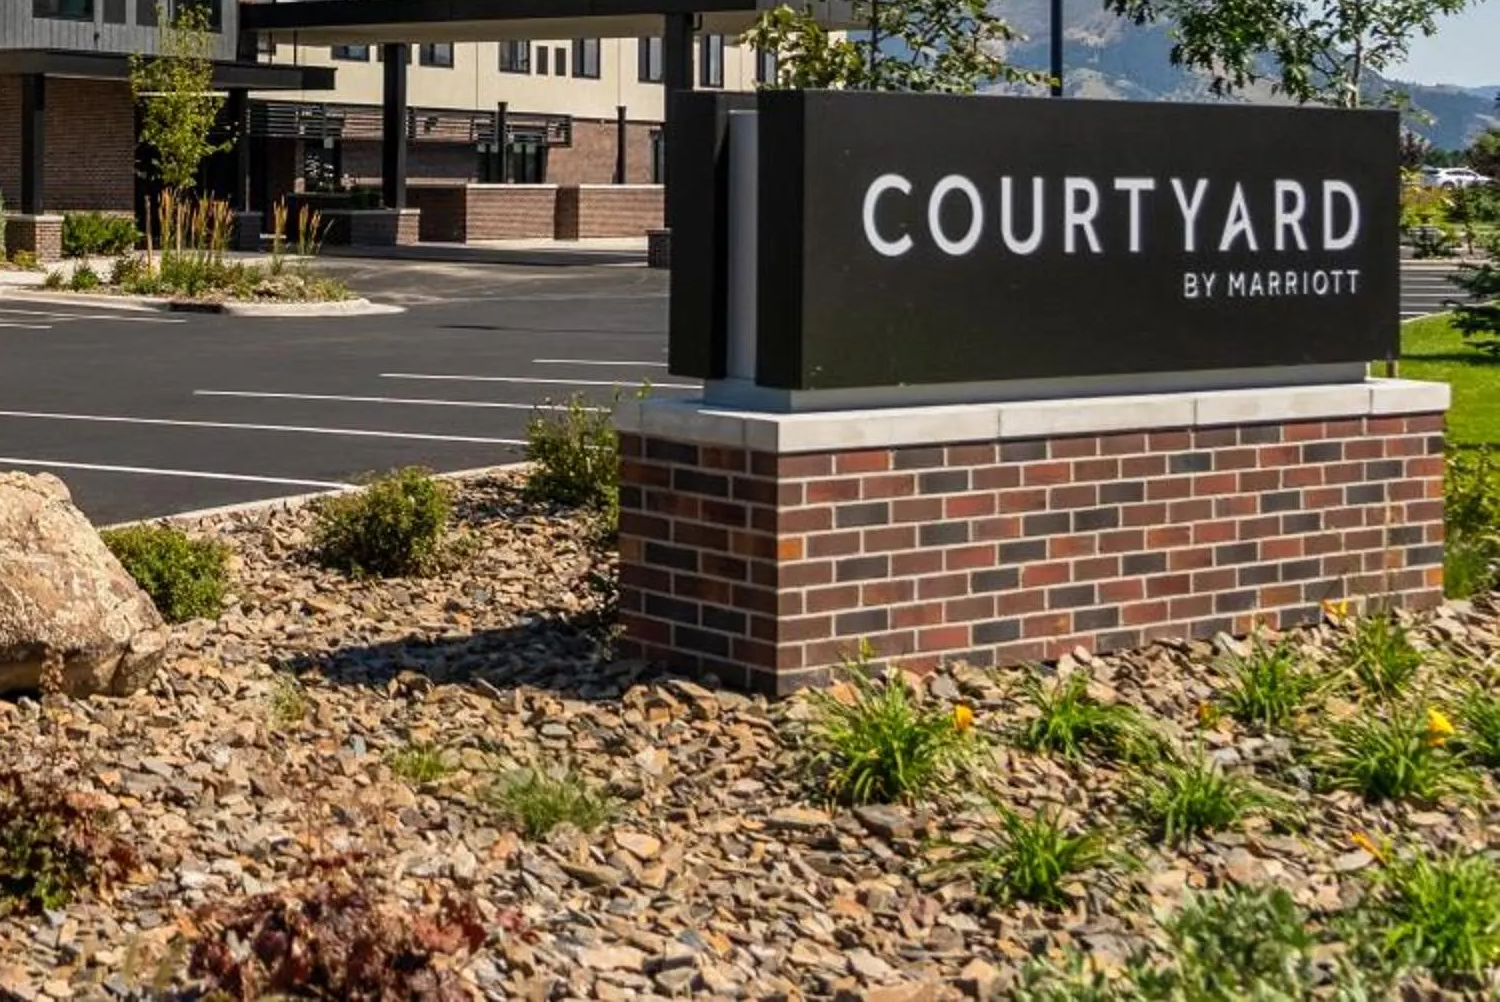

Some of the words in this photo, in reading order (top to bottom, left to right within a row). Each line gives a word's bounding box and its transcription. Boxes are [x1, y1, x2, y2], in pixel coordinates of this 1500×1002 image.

[862, 173, 1361, 257] COURTYARD
[1184, 272, 1217, 298] BY
[1228, 269, 1361, 297] MARRIOTT
